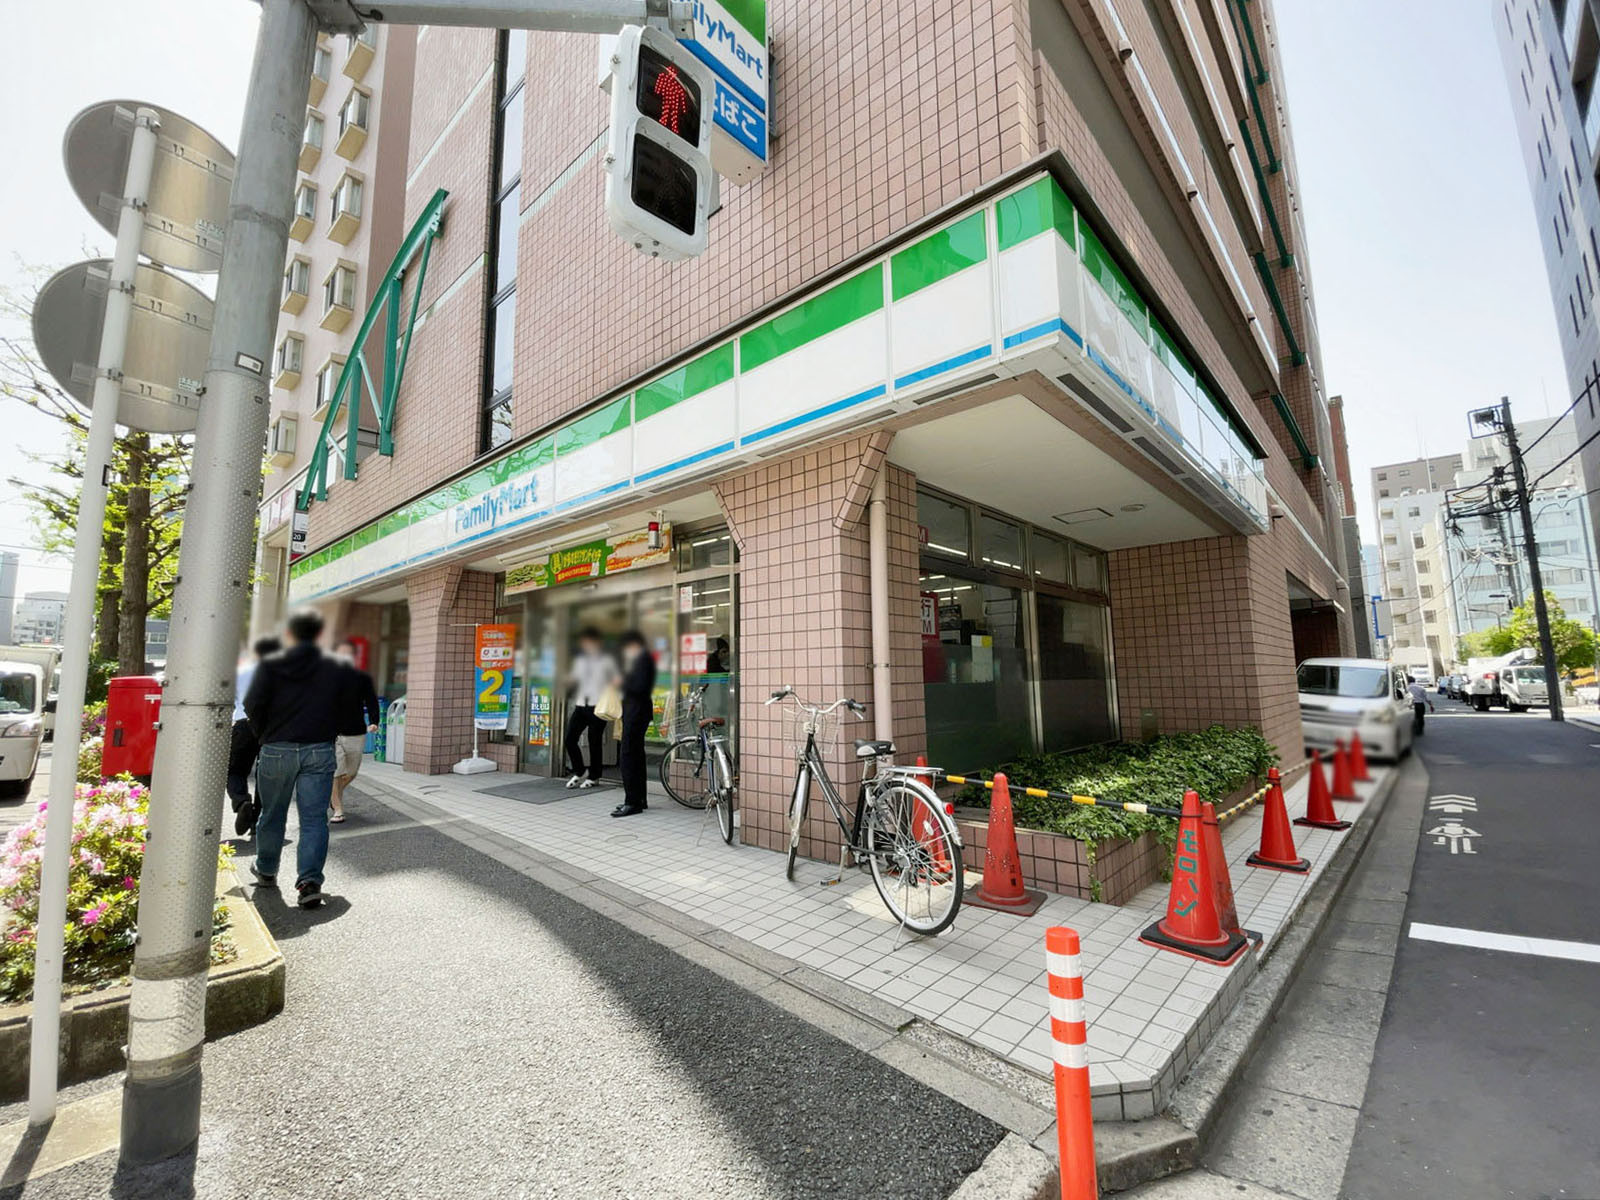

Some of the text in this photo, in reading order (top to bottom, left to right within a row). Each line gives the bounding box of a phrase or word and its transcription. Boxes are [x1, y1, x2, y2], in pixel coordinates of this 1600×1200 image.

[692, 0, 763, 79] ilyMart
[714, 92, 758, 142] ばこ
[455, 474, 537, 533] FamilyMart
